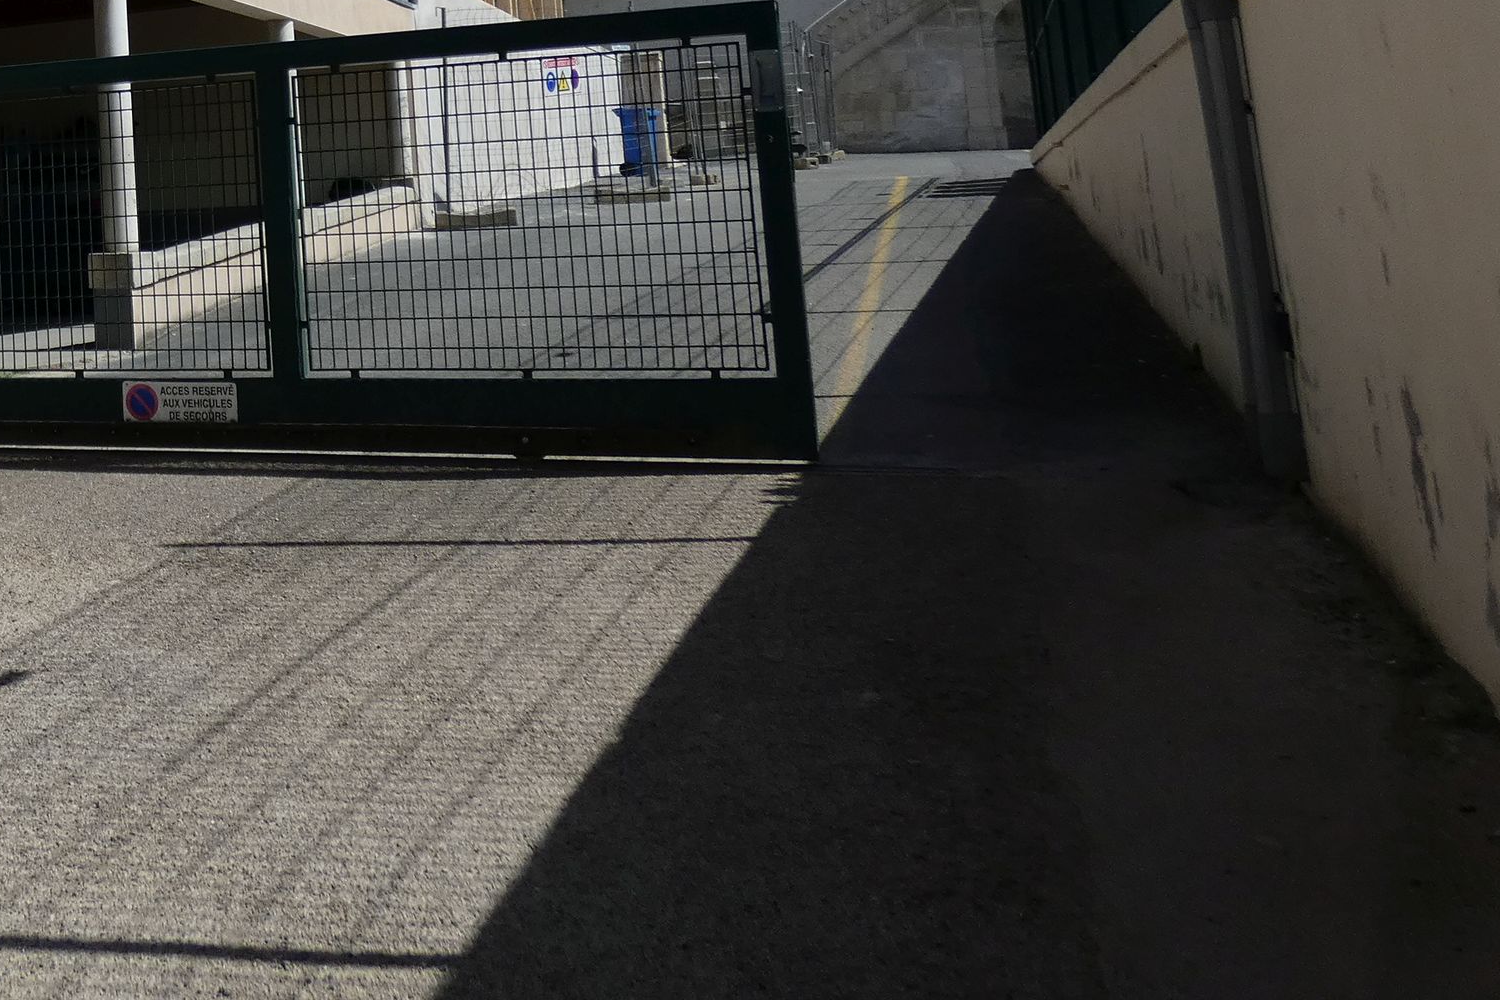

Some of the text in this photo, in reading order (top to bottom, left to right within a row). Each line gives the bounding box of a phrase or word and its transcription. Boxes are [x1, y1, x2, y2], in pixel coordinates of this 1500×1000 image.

[160, 385, 190, 396] ACCES
[163, 399, 232, 409] AUX VEHICULES
[169, 411, 228, 421] DE SECOURS
